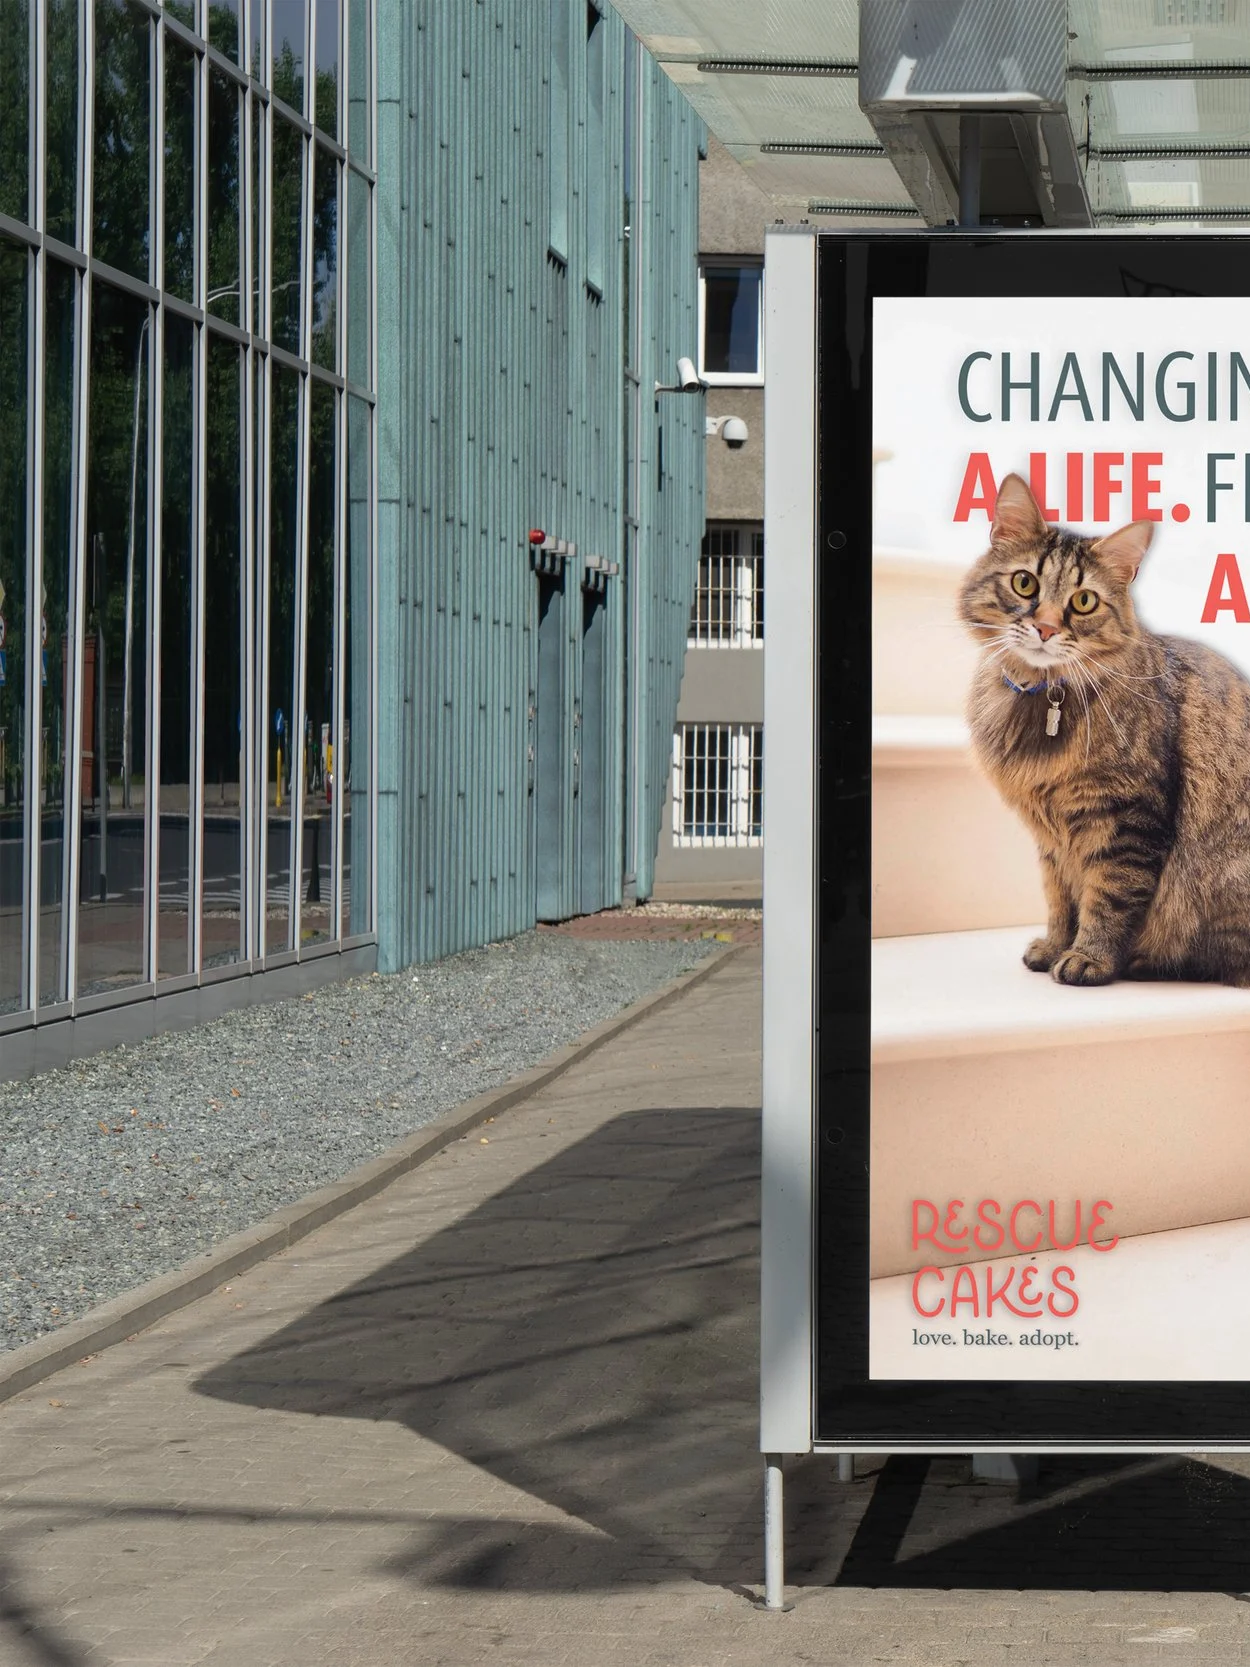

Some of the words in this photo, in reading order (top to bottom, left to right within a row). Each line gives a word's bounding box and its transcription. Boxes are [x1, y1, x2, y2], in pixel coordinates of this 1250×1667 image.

[953, 452, 999, 522] A
[1029, 452, 1191, 523] LIFE.
[912, 1199, 1119, 1254] RESCUE
[912, 1265, 1079, 1318] CAKES
[911, 1328, 957, 1346] love.
[961, 1328, 1014, 1346] bake.
[1018, 1328, 1080, 1351] adopt.
